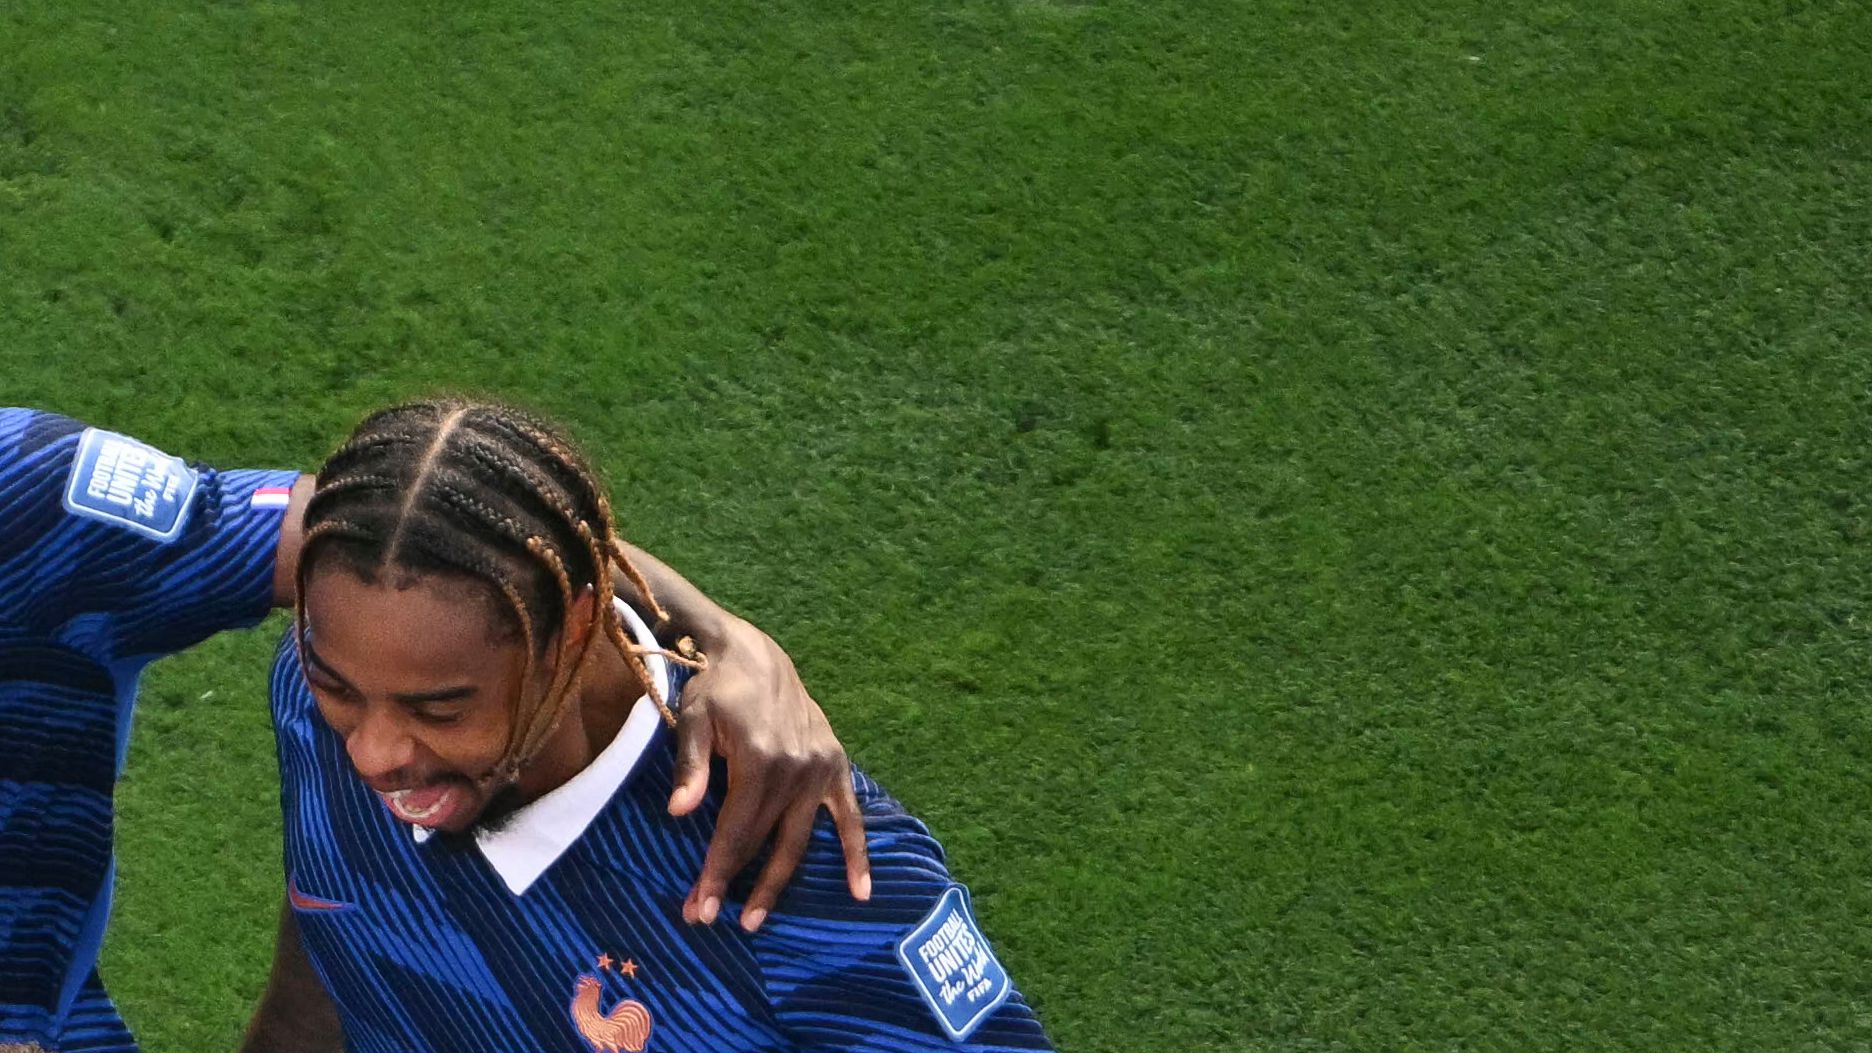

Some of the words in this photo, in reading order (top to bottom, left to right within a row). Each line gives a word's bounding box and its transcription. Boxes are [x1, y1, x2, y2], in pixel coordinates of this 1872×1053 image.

[918, 908, 963, 962] FOOTBALL
[928, 922, 975, 983] UNITES
[939, 980, 965, 1005] the
[966, 978, 992, 1002] FIFA
